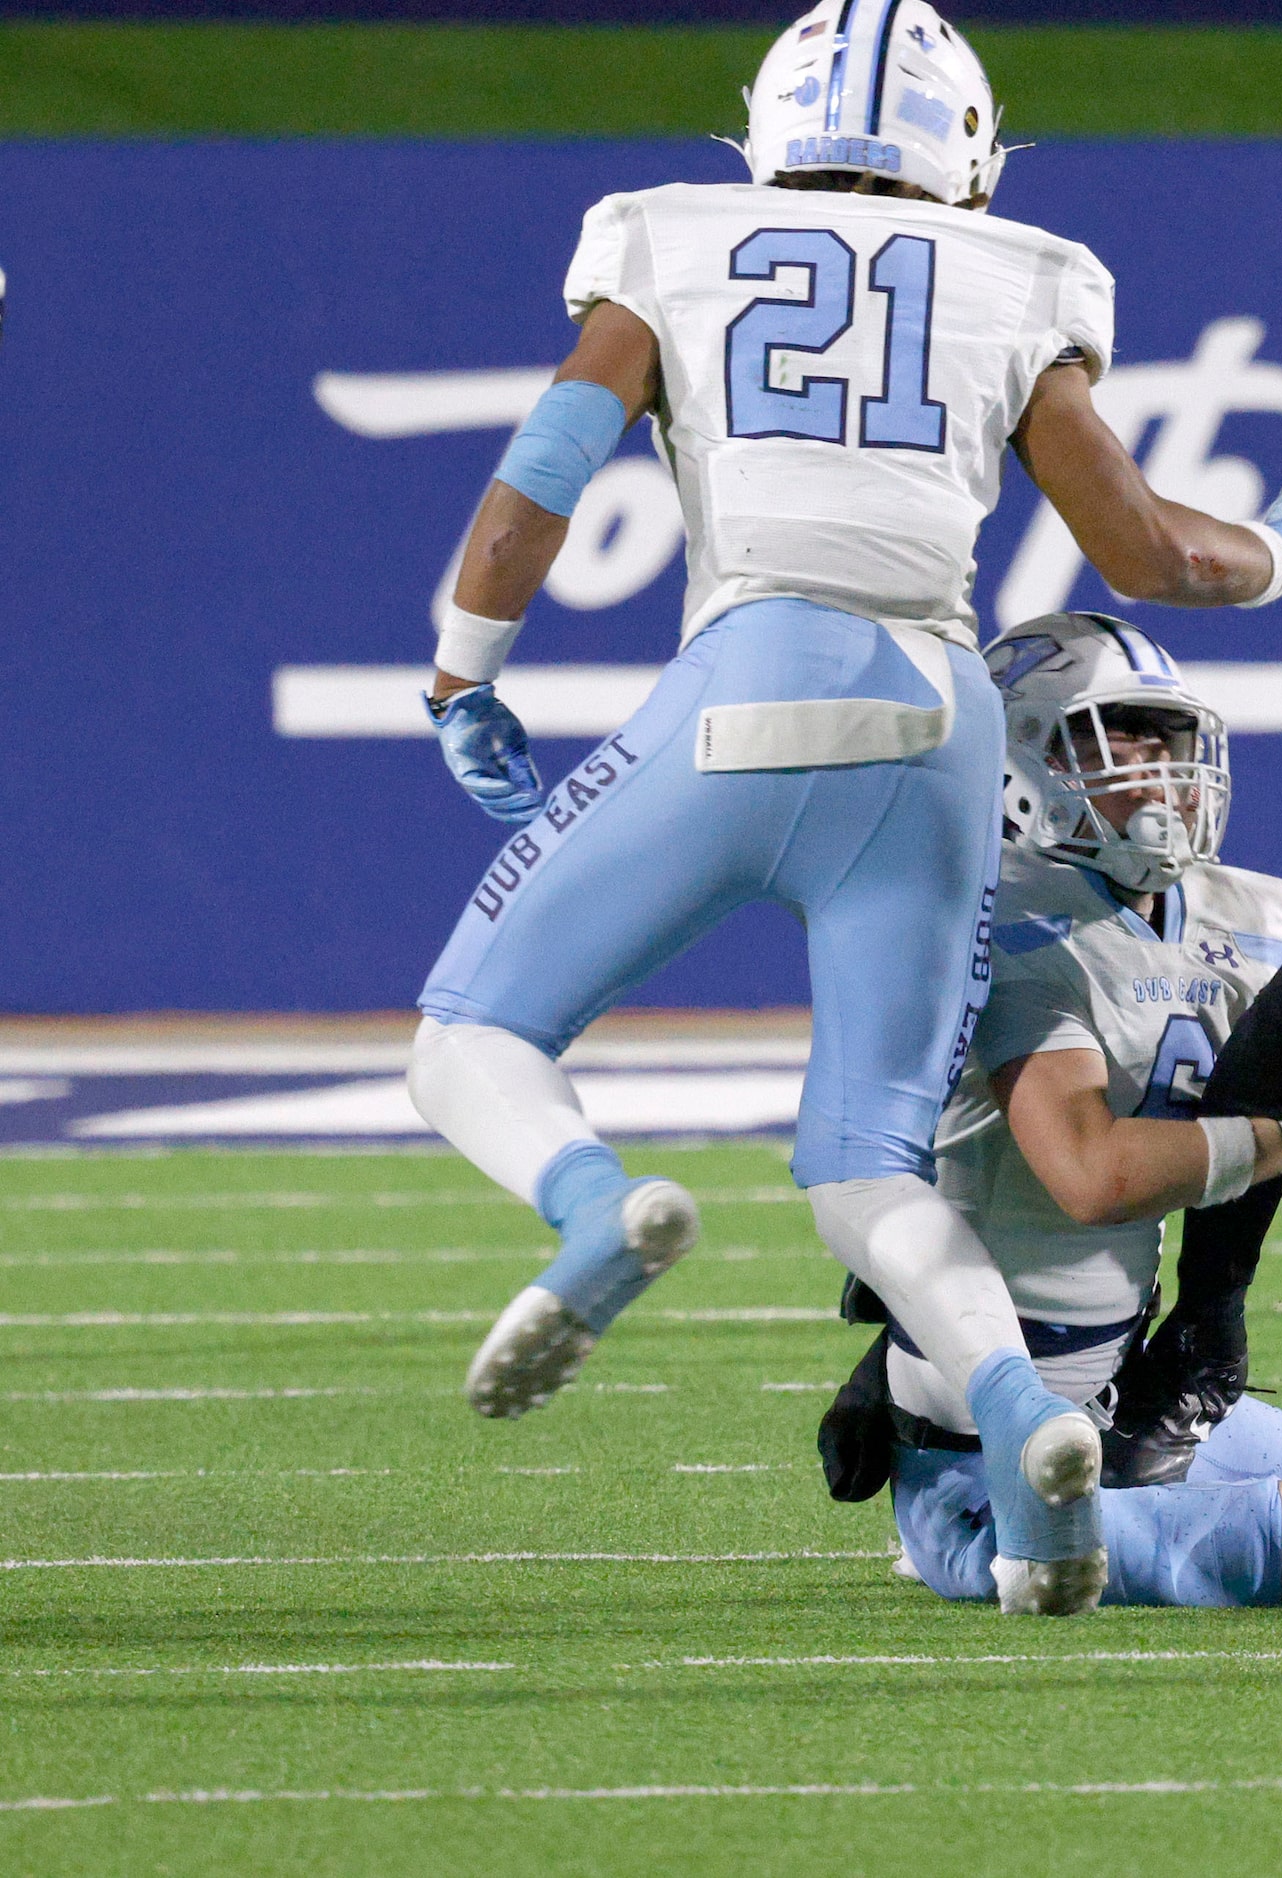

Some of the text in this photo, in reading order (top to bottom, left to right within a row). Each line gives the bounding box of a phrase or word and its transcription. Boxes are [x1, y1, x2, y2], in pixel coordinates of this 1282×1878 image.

[786, 136, 901, 172] RAIDERS
[724, 227, 946, 454] 21
[474, 733, 639, 922] DUB EAST
[1133, 976, 1172, 1003] DUB
